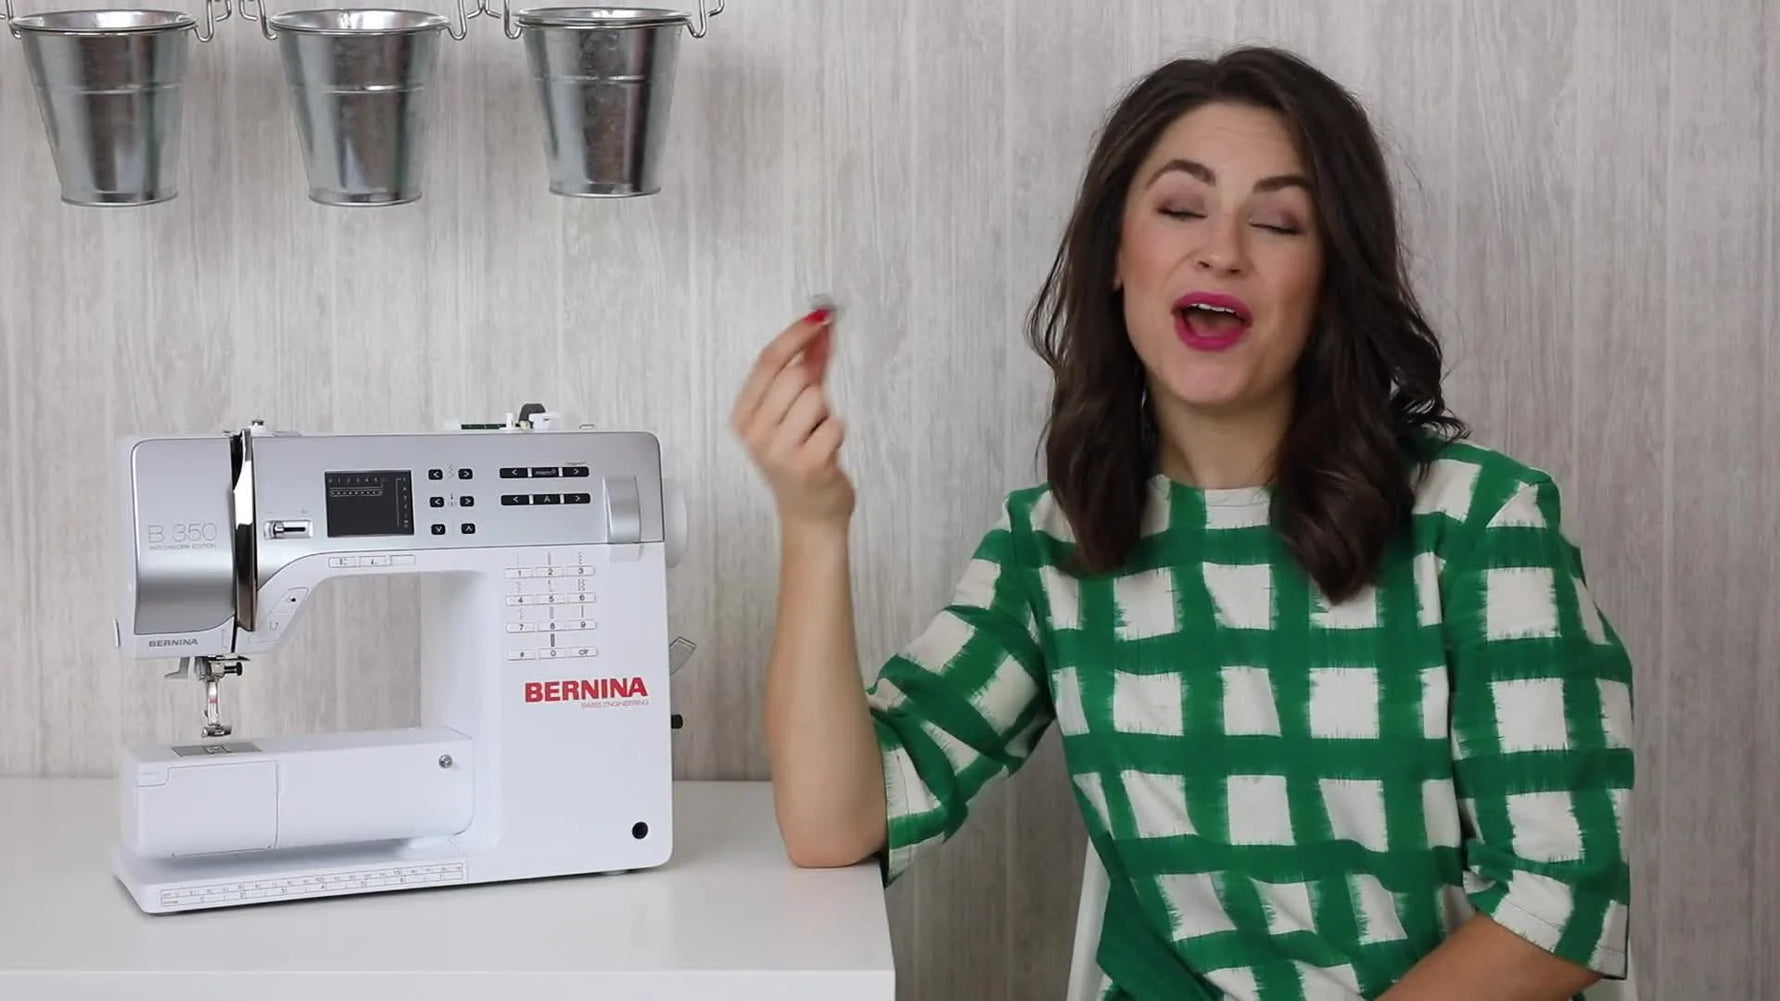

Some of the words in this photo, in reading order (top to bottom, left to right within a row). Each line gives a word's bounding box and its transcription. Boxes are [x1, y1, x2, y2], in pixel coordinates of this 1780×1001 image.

[543, 495, 551, 503] A
[147, 525, 165, 543] B
[172, 523, 217, 542] 350
[547, 568, 554, 576] 2
[578, 567, 584, 575] 3
[548, 595, 555, 603] 5
[550, 622, 555, 630] 8
[149, 638, 199, 648] BERNINA
[550, 649, 557, 657] 0
[525, 677, 649, 703] BERNINA
